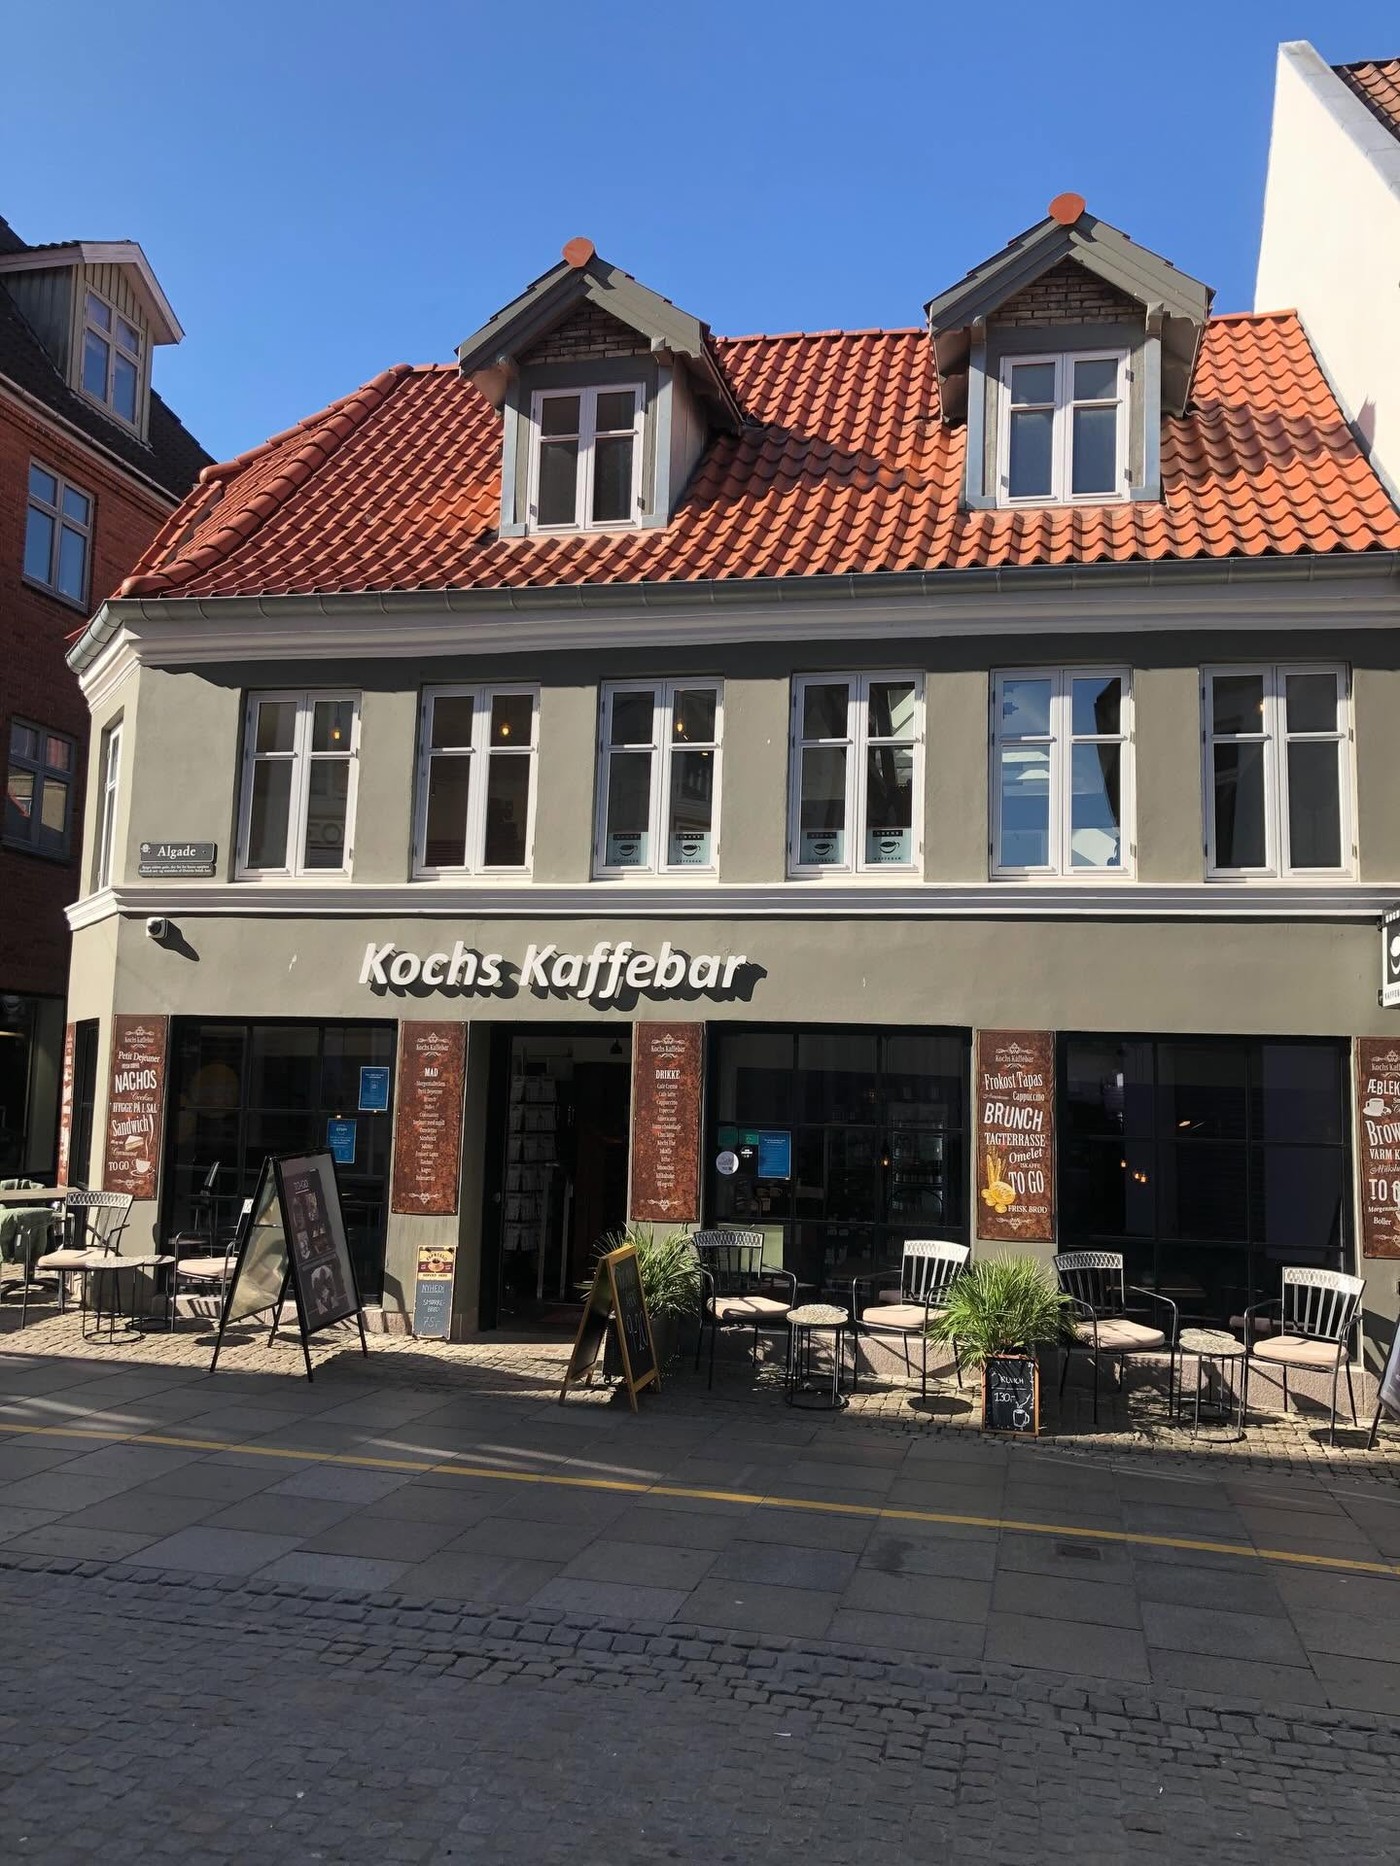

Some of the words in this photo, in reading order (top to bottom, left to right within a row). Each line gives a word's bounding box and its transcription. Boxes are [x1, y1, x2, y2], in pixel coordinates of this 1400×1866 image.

[157, 845, 196, 859] Algade
[358, 940, 502, 987] Kochs
[519, 941, 747, 999] Kaffebar
[118, 1051, 132, 1060] Petit
[424, 1067, 438, 1077] MAD
[655, 1069, 680, 1079] DRIKKE
[984, 1072, 1016, 1090] Frokost
[1016, 1071, 1043, 1089] Tapas
[115, 1069, 157, 1094] NACHOS
[112, 1114, 149, 1136] Sandwich
[984, 1102, 1043, 1132] BRUNCH
[984, 1132, 1046, 1147] TAGTERRASSE
[1009, 1147, 1042, 1164] Omelet
[1369, 1149, 1393, 1160] VARM
[108, 1161, 118, 1171] TO
[119, 1160, 130, 1171] GO
[1008, 1171, 1025, 1195] TO
[1028, 1170, 1044, 1194] GO
[1368, 1179, 1388, 1201] TO
